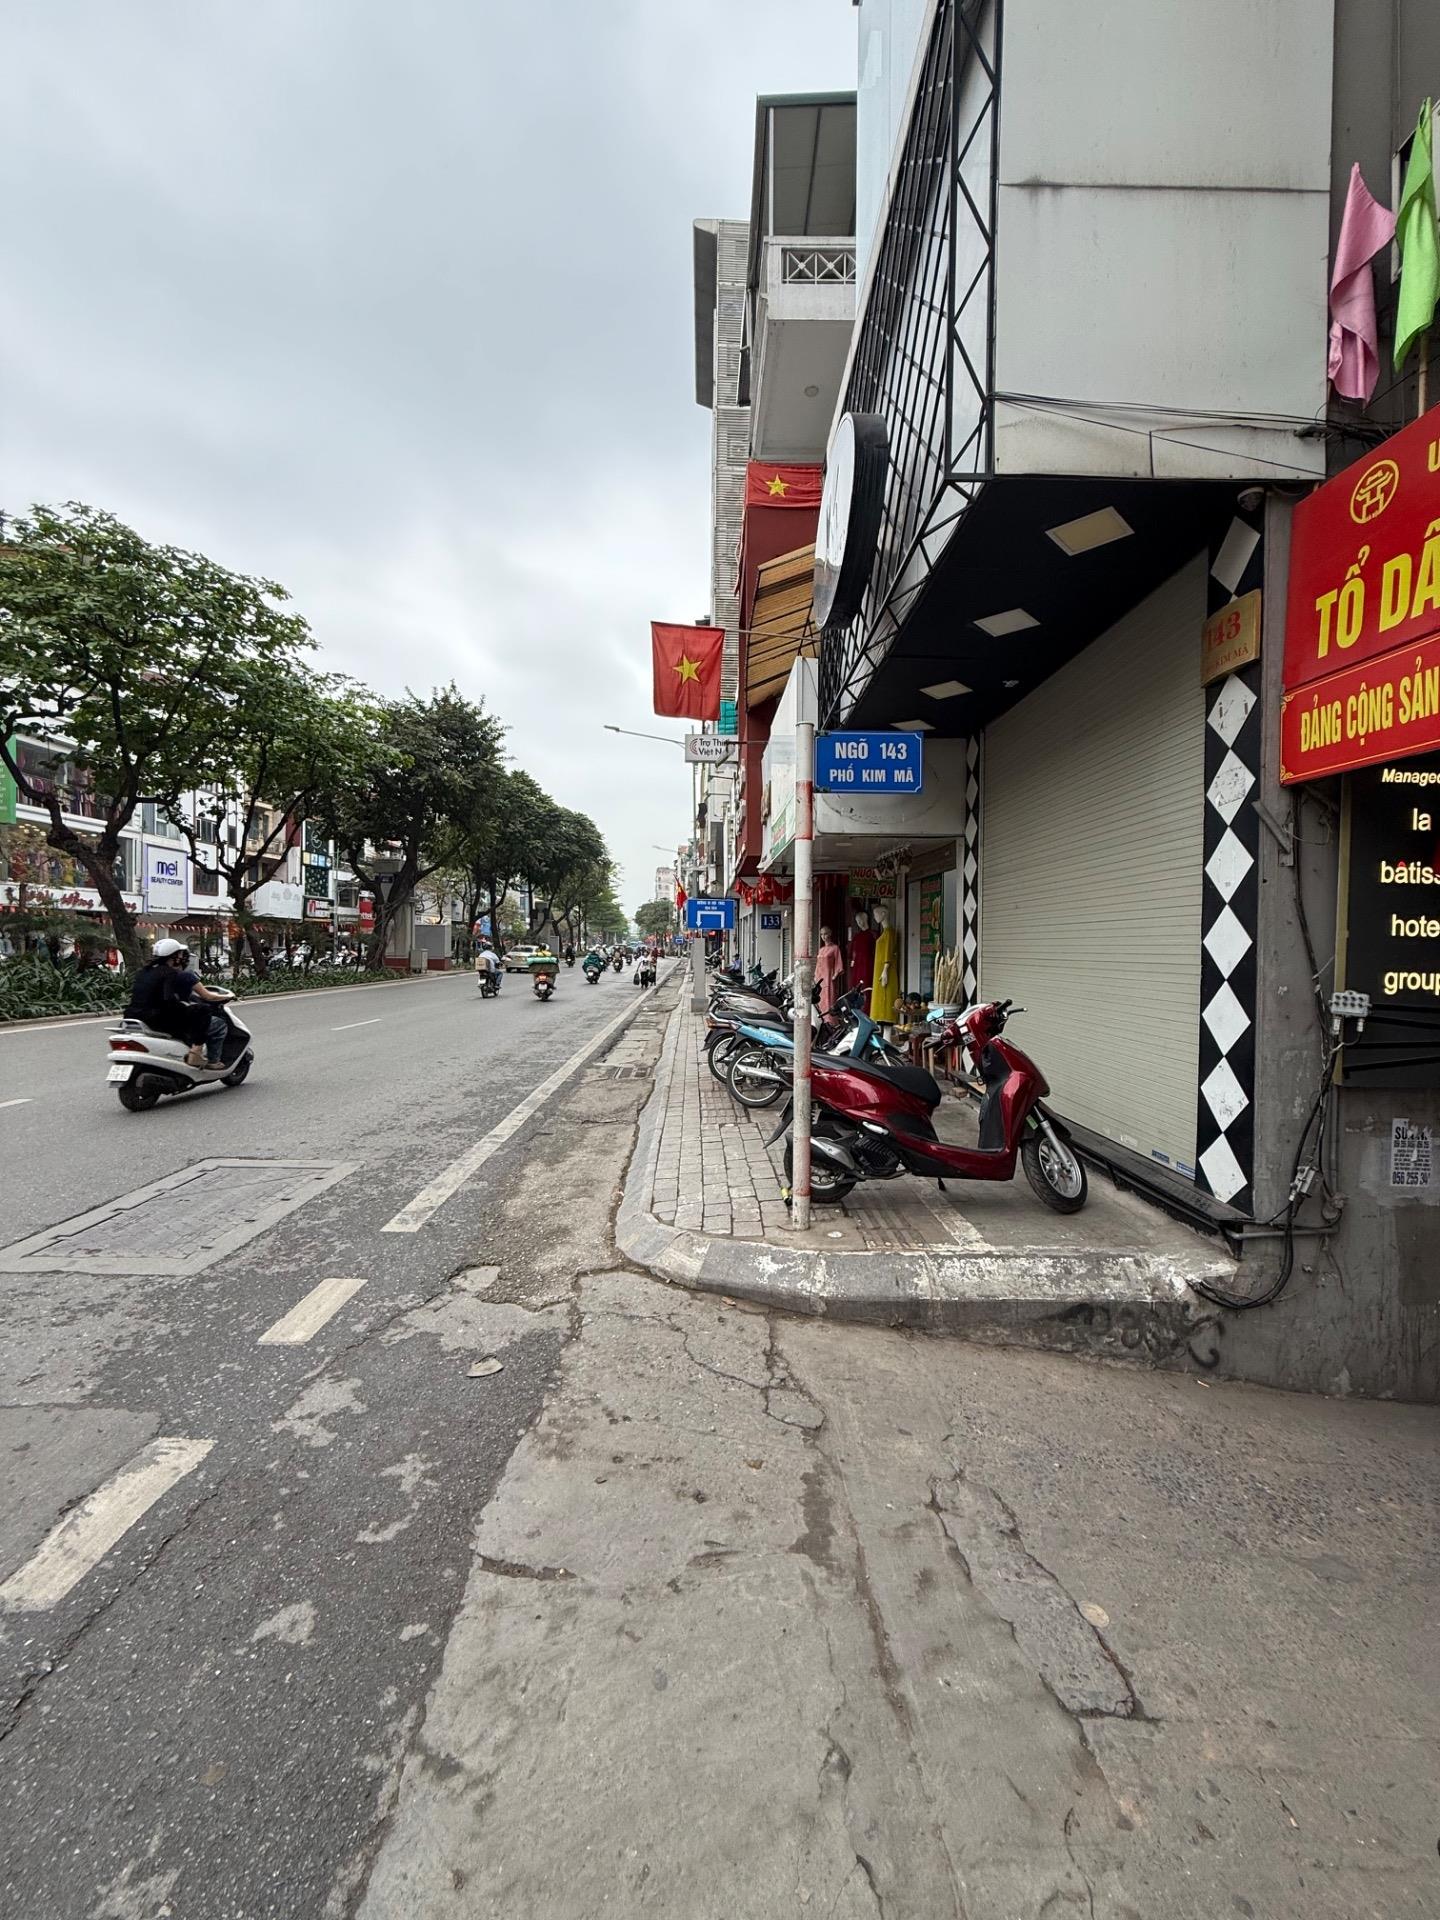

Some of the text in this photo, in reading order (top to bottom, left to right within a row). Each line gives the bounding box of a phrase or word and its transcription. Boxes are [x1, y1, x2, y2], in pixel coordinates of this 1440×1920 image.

[1316, 545, 1370, 659] TỔ
[1206, 610, 1241, 652] 143
[1301, 656, 1440, 753] ĐẢNG CỘNG SẢN
[835, 738, 907, 760] NGÕ 143
[829, 762, 914, 783] PHỐ KIM MÃ
[1412, 808, 1432, 832] la
[157, 860, 178, 876] mei
[763, 915, 780, 926] 133
